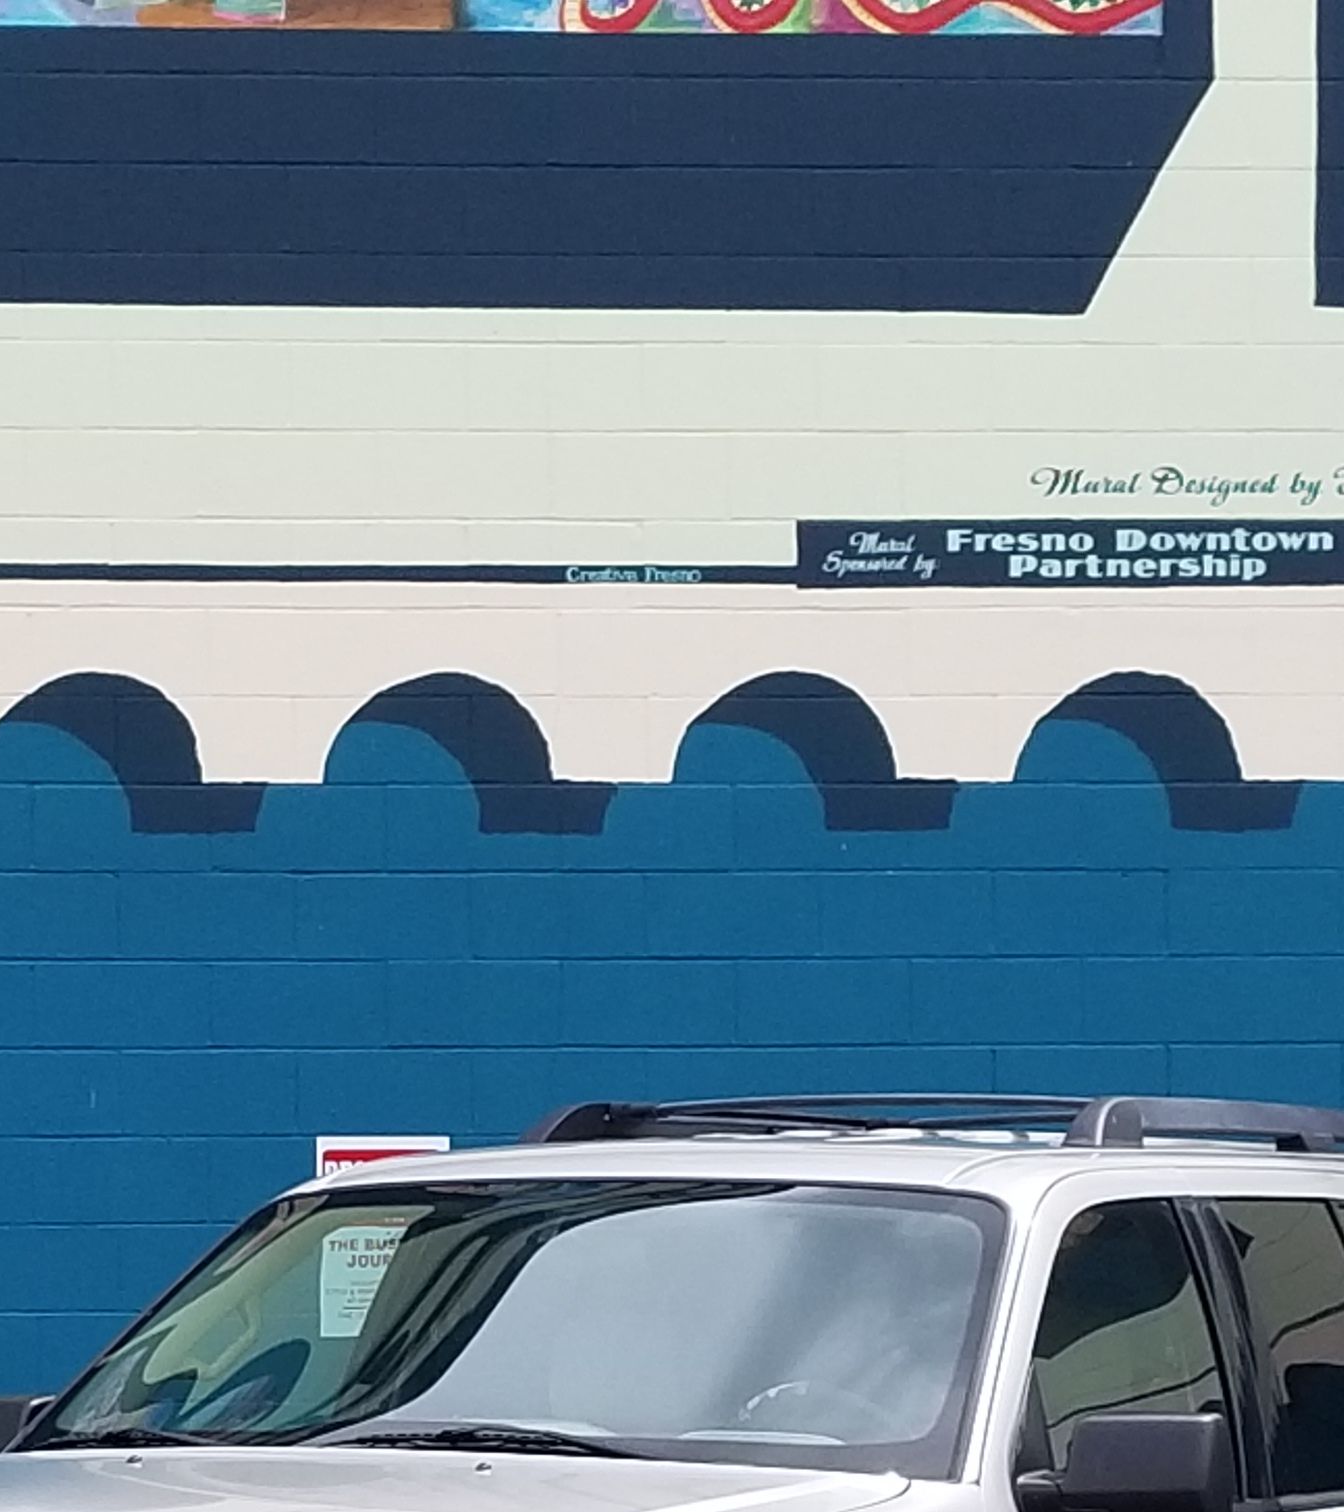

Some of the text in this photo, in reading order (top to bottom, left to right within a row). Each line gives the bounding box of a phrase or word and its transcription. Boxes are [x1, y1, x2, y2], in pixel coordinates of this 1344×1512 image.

[1030, 466, 1141, 497] Mural
[1151, 466, 1279, 506] Designed
[1290, 472, 1322, 505] by
[946, 528, 1334, 552] Fresno Downtown
[1008, 554, 1267, 580] Partnership
[329, 1240, 358, 1251] THE
